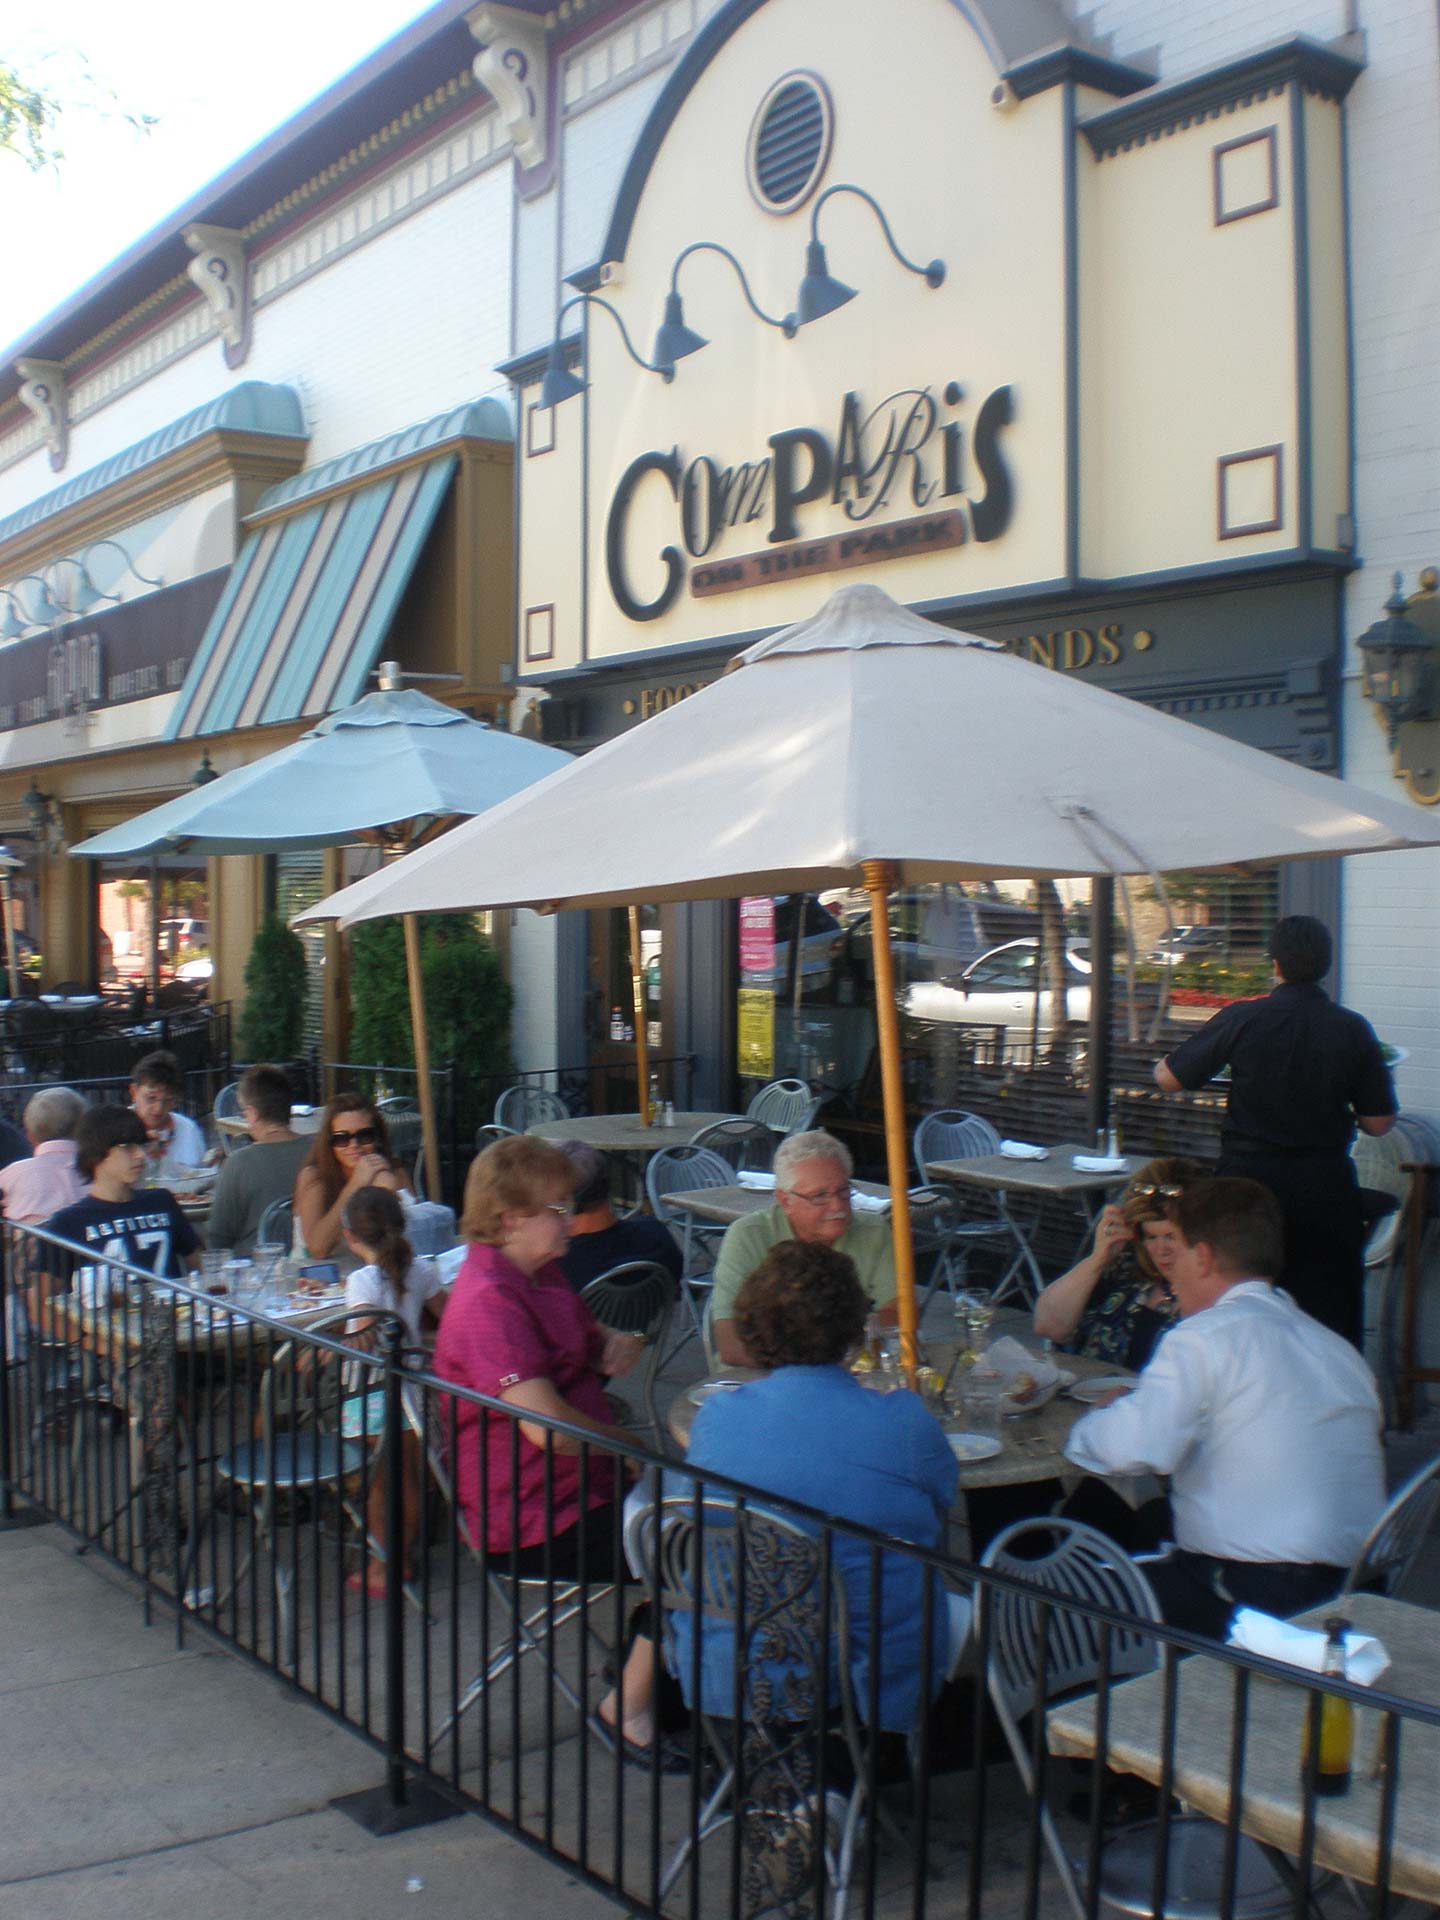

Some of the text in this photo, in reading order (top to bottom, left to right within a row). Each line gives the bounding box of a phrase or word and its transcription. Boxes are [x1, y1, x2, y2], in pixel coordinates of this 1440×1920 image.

[753, 545, 828, 576] THE
[839, 518, 954, 560] PARK
[640, 681, 711, 720] FOO
